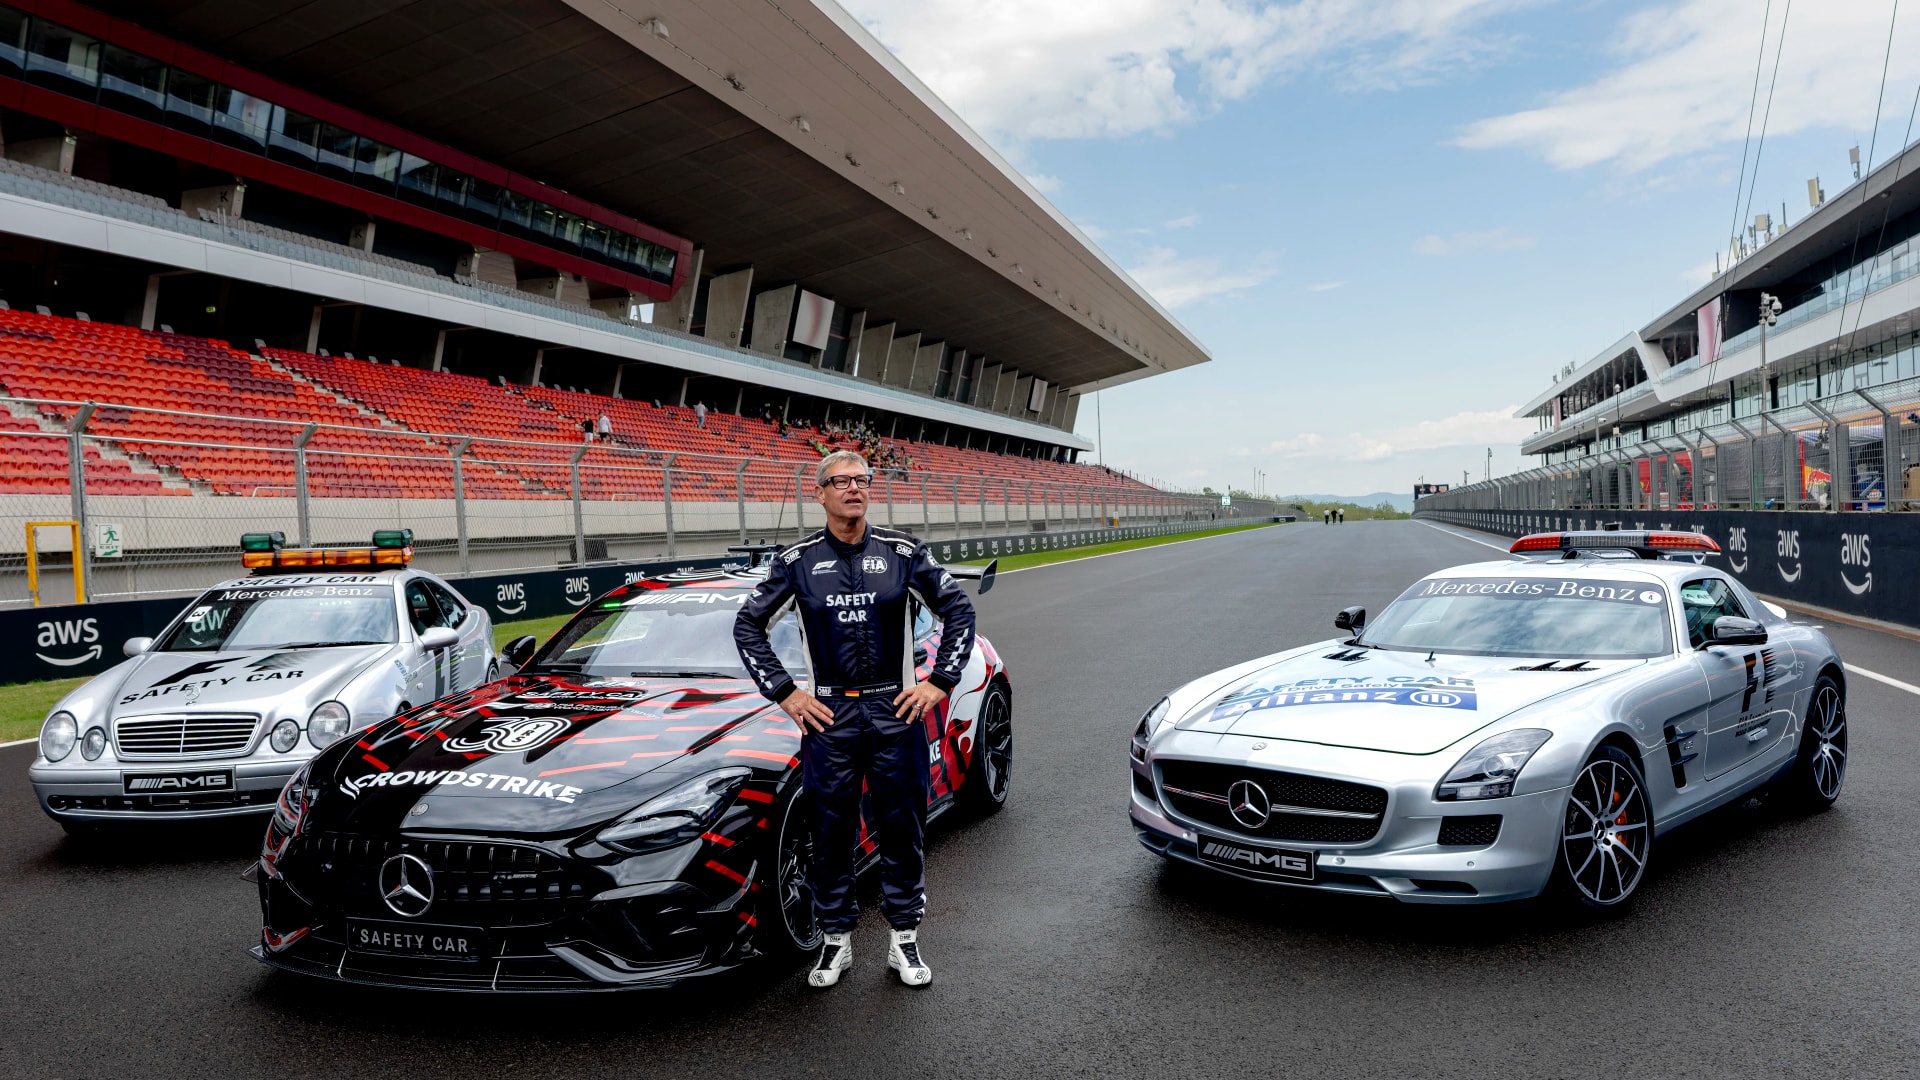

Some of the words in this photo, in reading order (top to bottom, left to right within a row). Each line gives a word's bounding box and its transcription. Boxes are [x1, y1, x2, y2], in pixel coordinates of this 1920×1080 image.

[1729, 527, 1747, 552] aws
[1778, 529, 1800, 559] aws
[785, 550, 801, 563] OMP
[896, 545, 913, 556] OMP
[1841, 533, 1871, 567] aws
[231, 576, 322, 587] SAFETY
[565, 576, 590, 594] aws
[1420, 581, 1635, 601] Mercedes-Benz
[217, 587, 373, 601] Mercedes-Benz
[497, 583, 525, 601] aws
[670, 593, 748, 604] AM
[826, 592, 877, 607] SAFETY
[838, 610, 867, 622] CAR
[37, 618, 99, 647] aws
[120, 677, 237, 705] SAFETY
[246, 670, 304, 682] CAR
[1238, 676, 1373, 696] SAFETY
[1386, 676, 1475, 686] CAR
[1286, 684, 1333, 693] Drive
[1226, 690, 1397, 717] Allianz
[512, 723, 545, 743] YRS
[158, 774, 227, 789] AMG
[354, 770, 583, 804] CROWDSTRIKE
[1231, 848, 1307, 872] AMG
[360, 929, 425, 948] SAFETY
[433, 937, 468, 952] CAR
